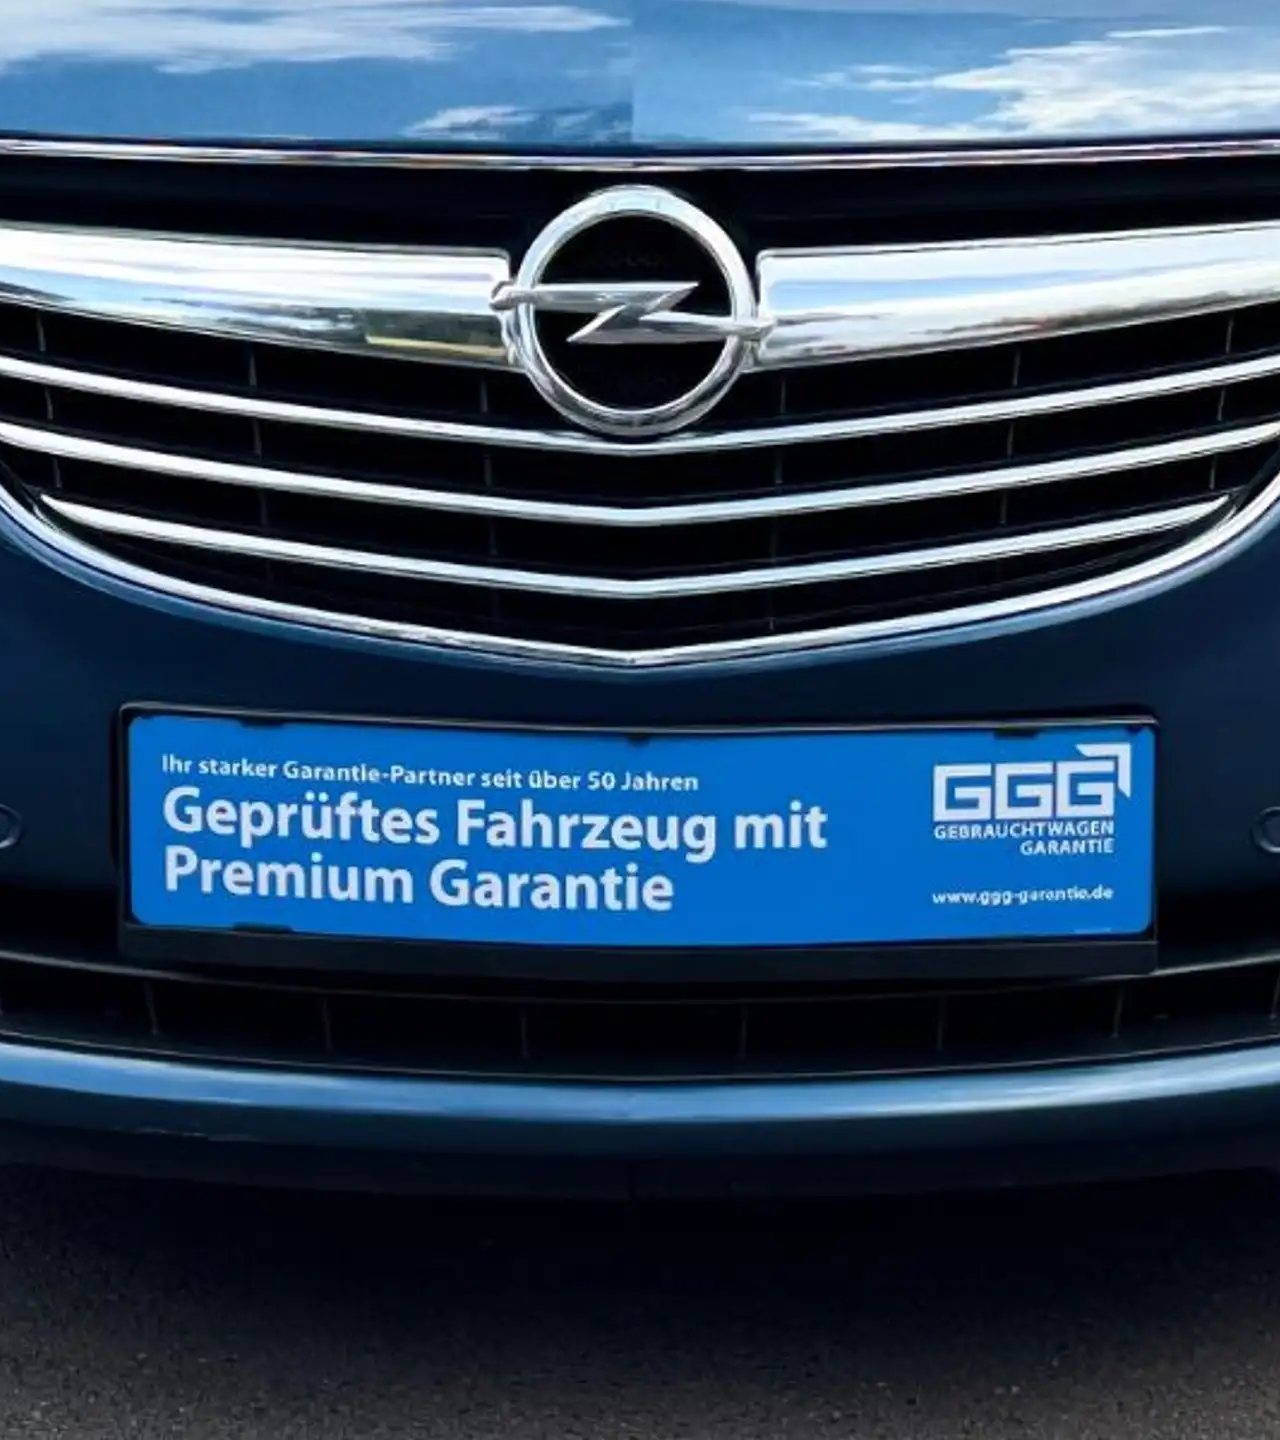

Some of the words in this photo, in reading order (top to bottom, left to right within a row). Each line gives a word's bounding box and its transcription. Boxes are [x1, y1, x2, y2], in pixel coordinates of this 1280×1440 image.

[162, 754, 192, 773] Ihr
[198, 758, 278, 777] starker
[282, 760, 476, 786] Garantie-Partner
[481, 769, 522, 788] seit
[528, 769, 581, 790] über
[588, 771, 616, 790] 50
[620, 772, 698, 791] Jahren
[933, 761, 1116, 822] GGG
[163, 785, 440, 849] Geprüftes
[457, 798, 717, 864] Fahrzeug
[734, 800, 827, 850] mit
[934, 820, 1114, 839] GEBRAUCHTWAGEN
[1020, 837, 1114, 855] GARANTIE
[165, 845, 413, 903] Premium
[429, 859, 674, 912] Garantie
[932, 884, 1113, 906] www.ggg-garantie.de
